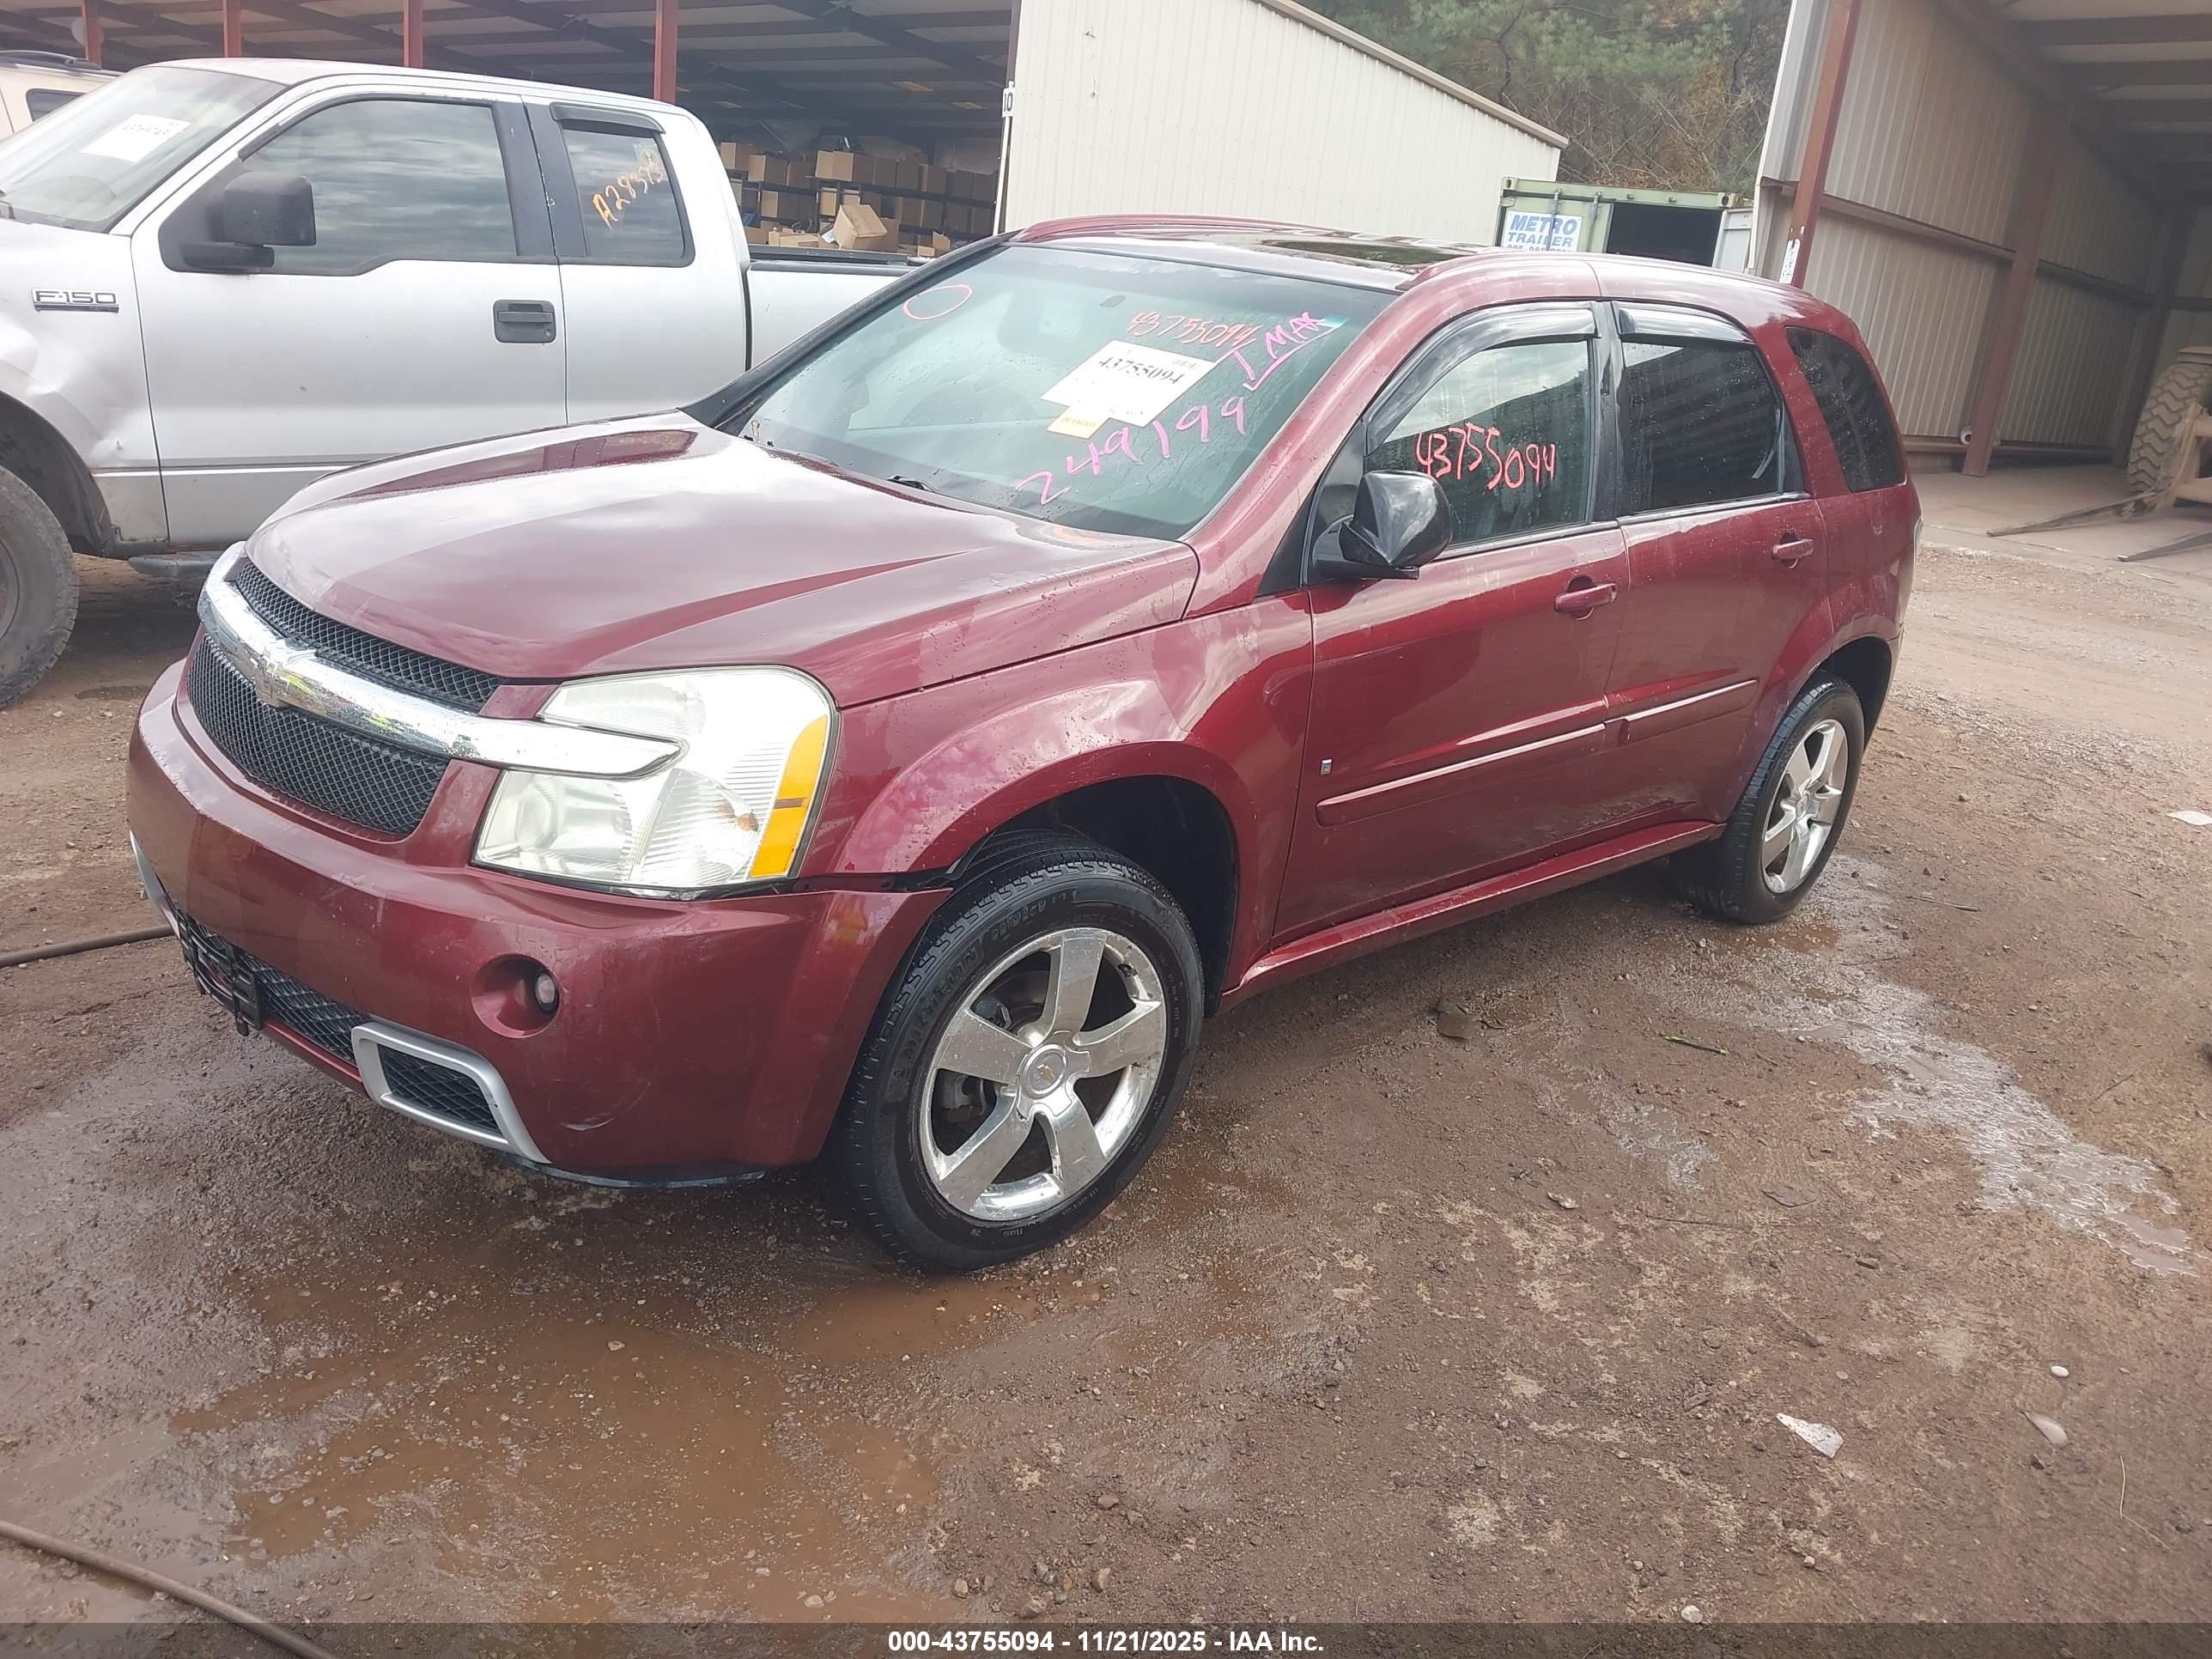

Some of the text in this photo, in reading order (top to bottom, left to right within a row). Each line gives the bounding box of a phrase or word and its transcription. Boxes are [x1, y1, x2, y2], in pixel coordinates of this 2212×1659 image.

[1510, 214, 1578, 235] METRO
[1127, 311, 1263, 348] 43755094
[1098, 356, 1185, 385] 43755094
[1015, 396, 1247, 505] 249199
[1417, 422, 1556, 490] 43755094
